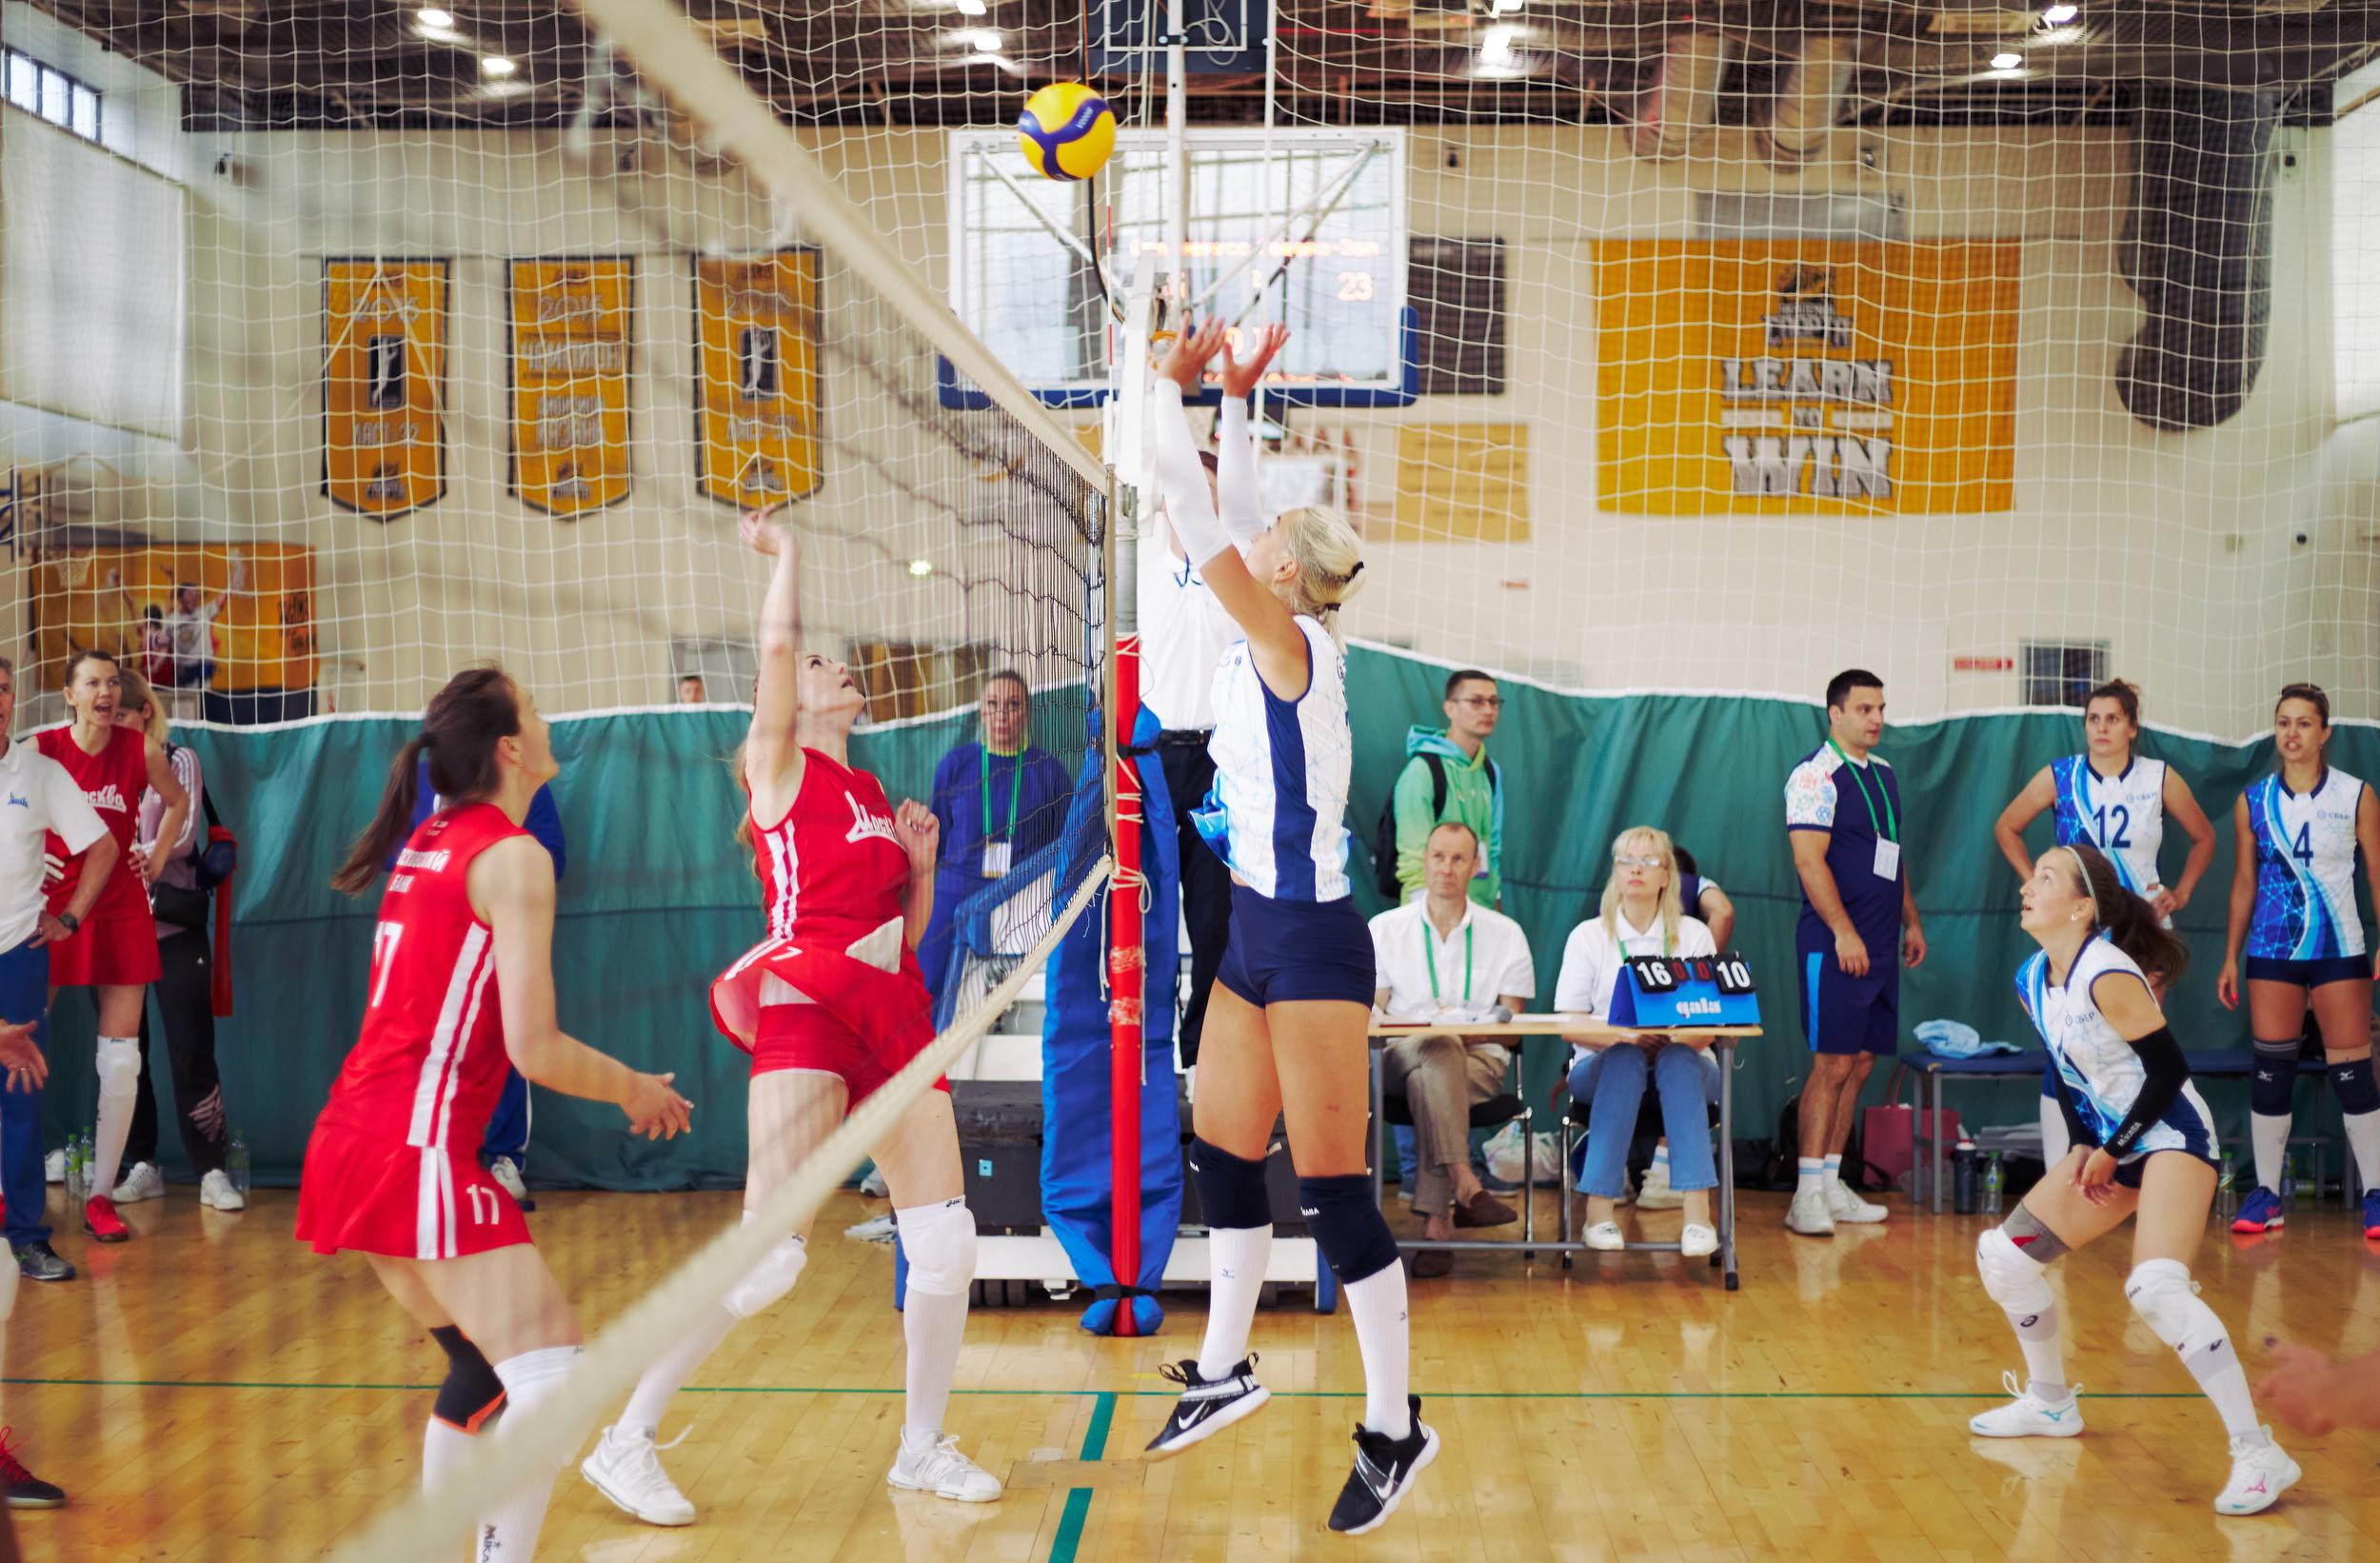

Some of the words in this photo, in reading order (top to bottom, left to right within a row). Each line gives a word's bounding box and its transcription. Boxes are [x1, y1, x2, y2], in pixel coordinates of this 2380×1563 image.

[1337, 271, 1374, 301] 23
[1722, 359, 1893, 403] LEARN
[1722, 435, 1893, 498] WIN
[84, 783, 127, 813] осква
[2093, 804, 2132, 849] 12
[2292, 821, 2314, 868] 4
[1636, 961, 1673, 987] 16
[1671, 961, 1687, 980] 0
[1696, 961, 1711, 980] 0
[1716, 960, 1752, 989] 10
[1676, 998, 1722, 1019] gala
